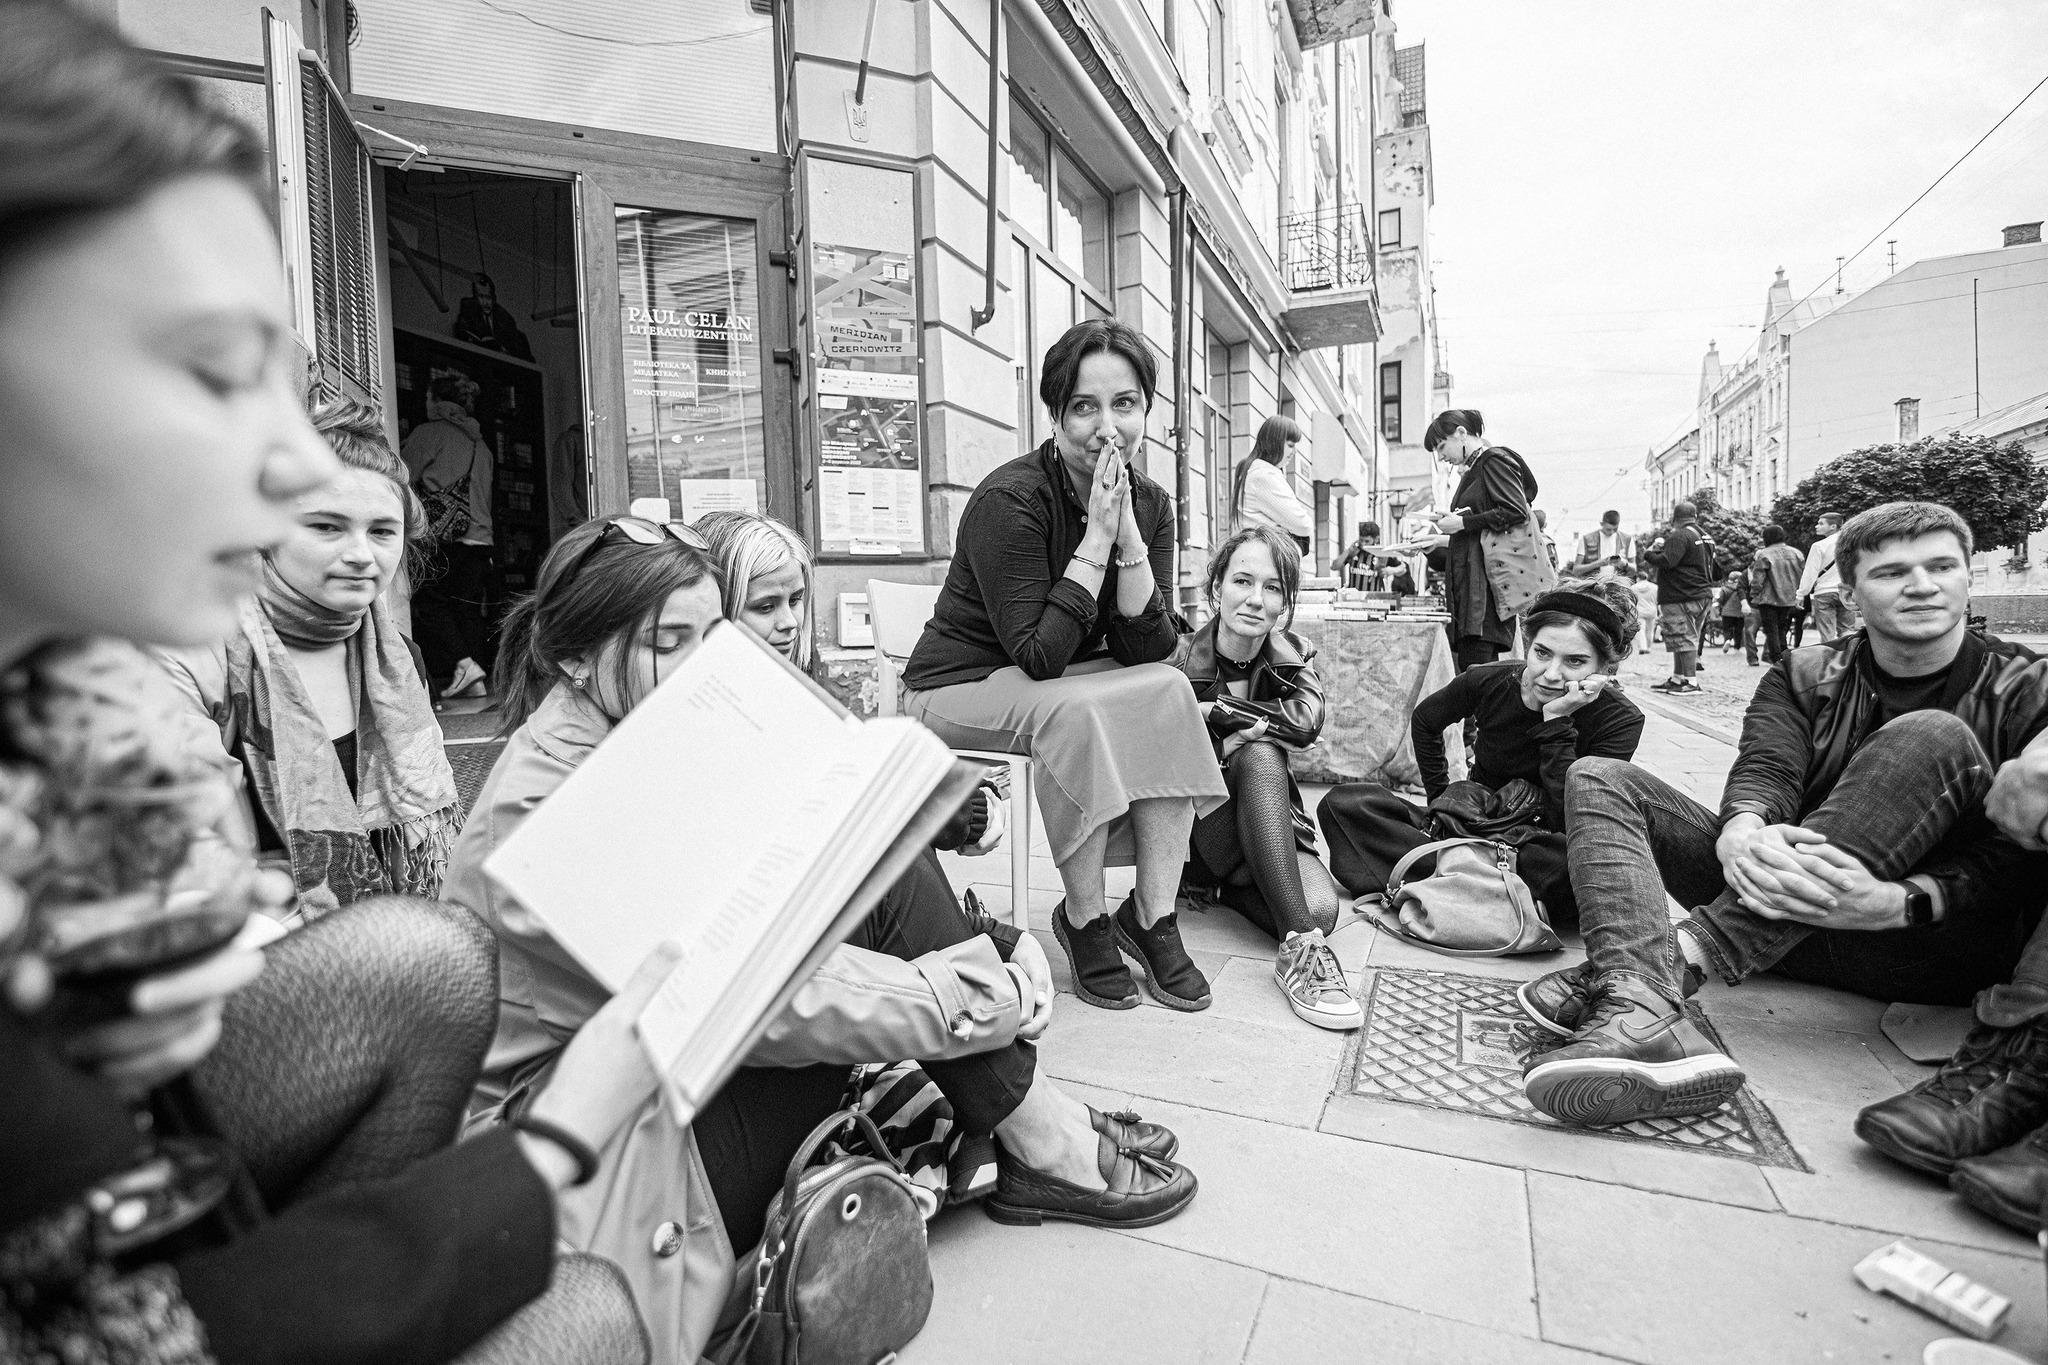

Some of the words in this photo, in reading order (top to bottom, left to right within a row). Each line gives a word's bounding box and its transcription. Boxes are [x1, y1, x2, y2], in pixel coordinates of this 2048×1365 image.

[629, 307, 680, 325] PAUL
[685, 311, 752, 331] CELAN
[629, 324, 753, 342] LITERATURZENTRUM
[830, 325, 888, 342] MERIDIAN
[831, 345, 902, 353] CZERNOWITZ
[633, 359, 680, 369] БІБЛІОТЕКА
[682, 361, 691, 370] ТА
[633, 368, 679, 378] МЕДІАТЕКА
[705, 368, 747, 378] КНИГАРНЯ
[633, 388, 668, 397] ПРОСТІР
[669, 389, 695, 399] ПОДІЙ
